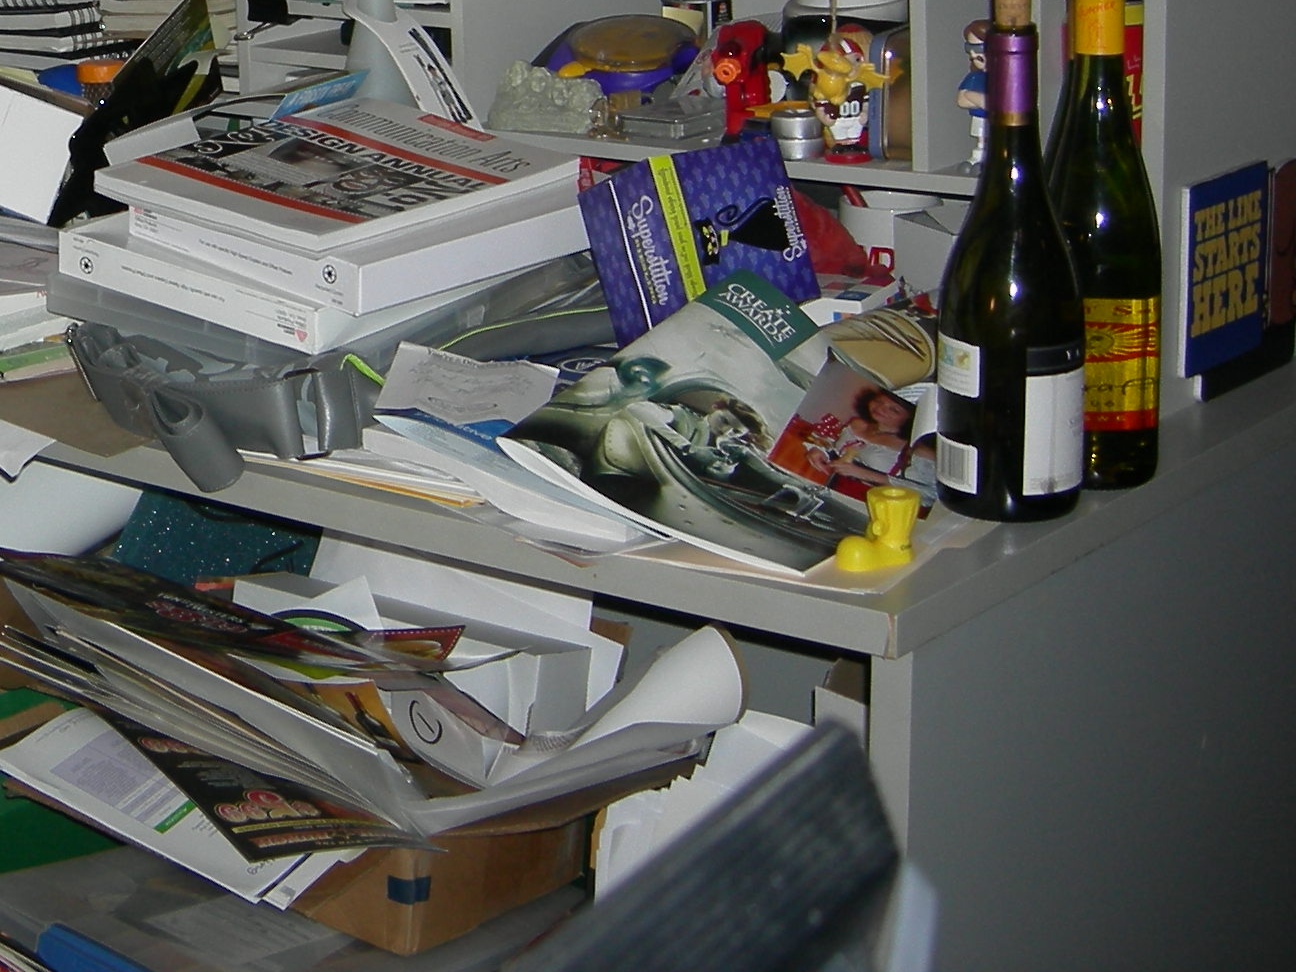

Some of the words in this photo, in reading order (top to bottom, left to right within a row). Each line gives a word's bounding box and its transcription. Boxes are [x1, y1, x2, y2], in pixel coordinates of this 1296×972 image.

[839, 101, 860, 118] 00
[318, 103, 479, 166] Communication
[473, 148, 533, 176] Arts
[362, 150, 487, 192] ANNUAL
[773, 184, 802, 263] Superstition
[1194, 202, 1226, 242] THE
[1228, 190, 1262, 230] LINE
[631, 195, 672, 306] Superstition
[1192, 223, 1262, 284] STARTS
[718, 290, 784, 344] AWARDS
[726, 282, 797, 340] CREATE
[1190, 260, 1260, 339] HERE
